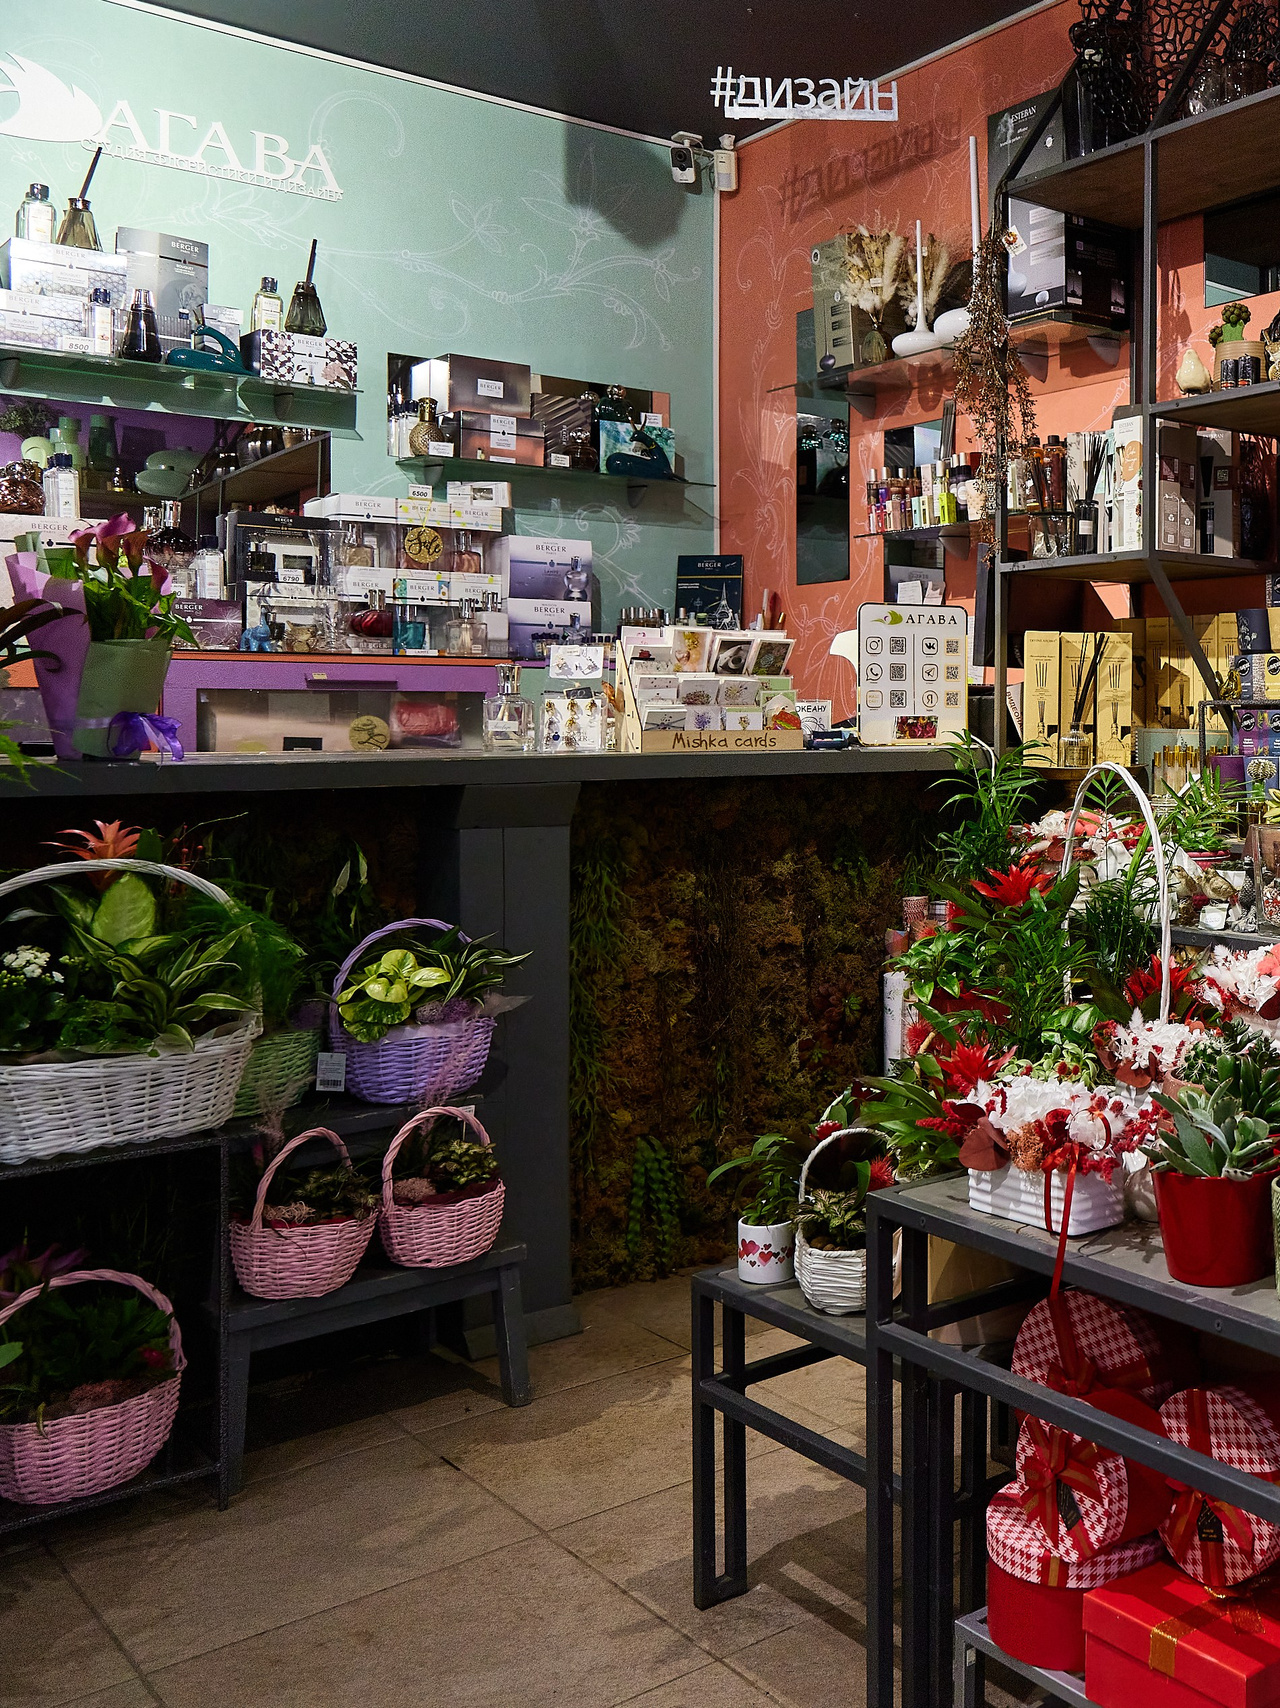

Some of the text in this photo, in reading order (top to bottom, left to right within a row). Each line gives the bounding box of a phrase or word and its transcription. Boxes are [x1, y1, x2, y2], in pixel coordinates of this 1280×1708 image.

[710, 66, 899, 119] #дизайн
[100, 99, 344, 194] АГАВА
[171, 241, 199, 253] BERGER
[55, 249, 86, 259] BERGER
[8, 295, 40, 305] BERGER
[68, 342, 90, 351] 8500
[297, 339, 323, 348] BERGER
[479, 383, 502, 391] BERGER
[492, 417, 515, 426] BERGER
[412, 490, 428, 498] 6500
[31, 523, 68, 531] BERGER
[535, 544, 567, 553] BERGER
[174, 602, 203, 611] BERGER
[534, 606, 566, 614] BERGER
[905, 613, 958, 625] АГАВА
[1006, 691, 1023, 731] ВИДЕОНА
[672, 732, 777, 750] Mishka cards
